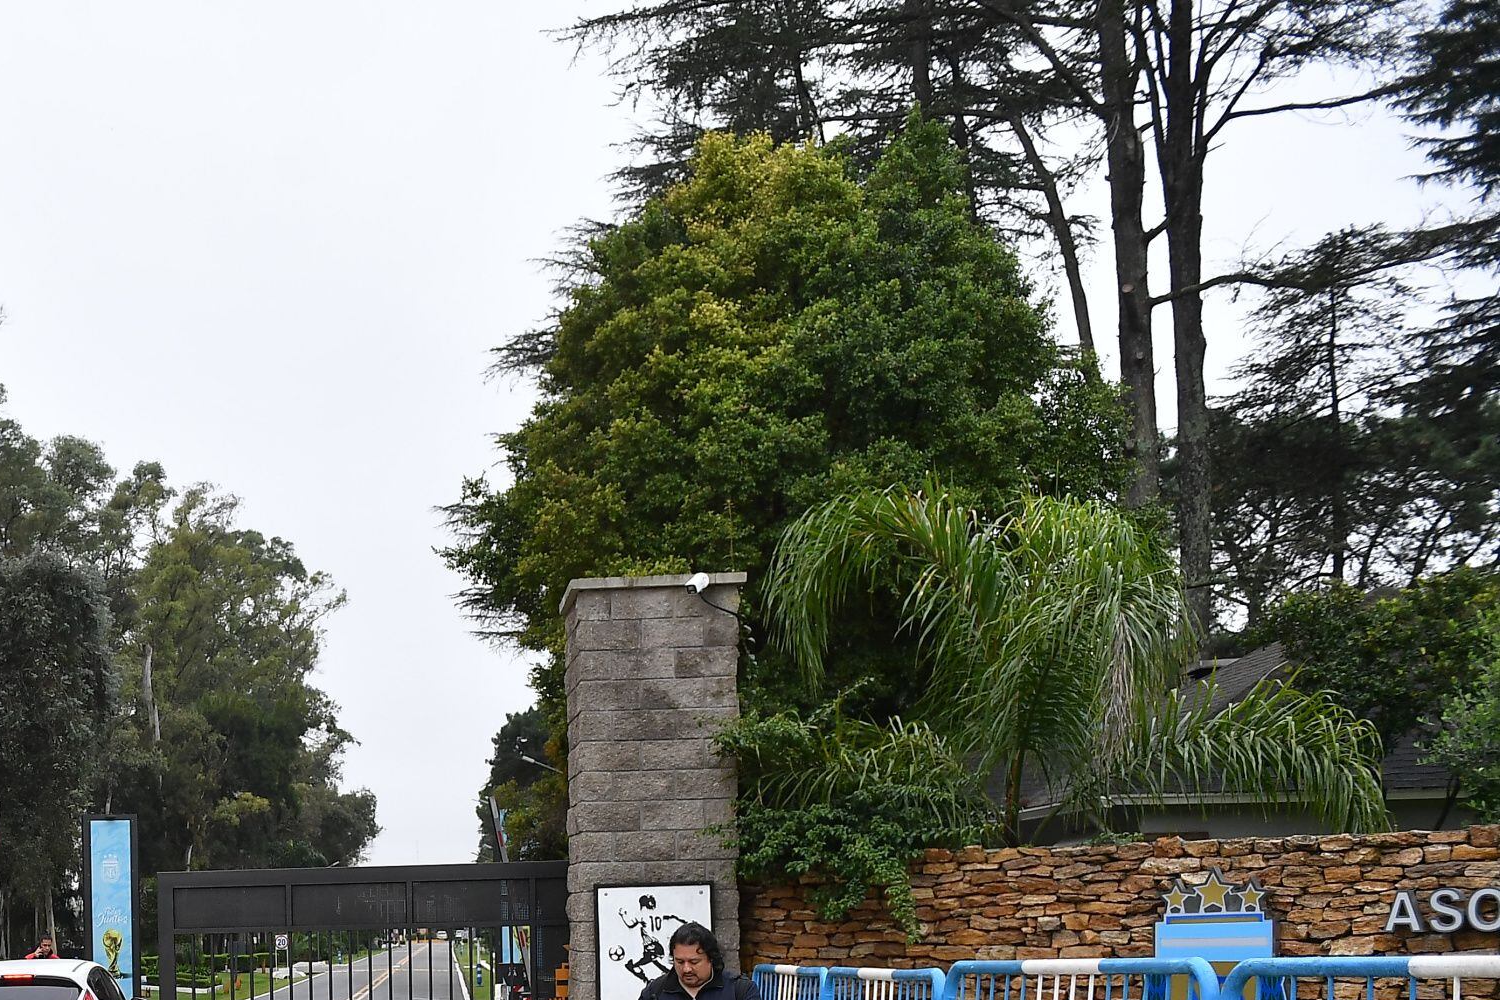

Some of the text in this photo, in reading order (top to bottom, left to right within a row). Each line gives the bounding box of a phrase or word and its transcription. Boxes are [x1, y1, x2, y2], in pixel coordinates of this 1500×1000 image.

[1385, 888, 1500, 932] ASO
[649, 915, 661, 932] 10
[277, 938, 286, 946] 20
